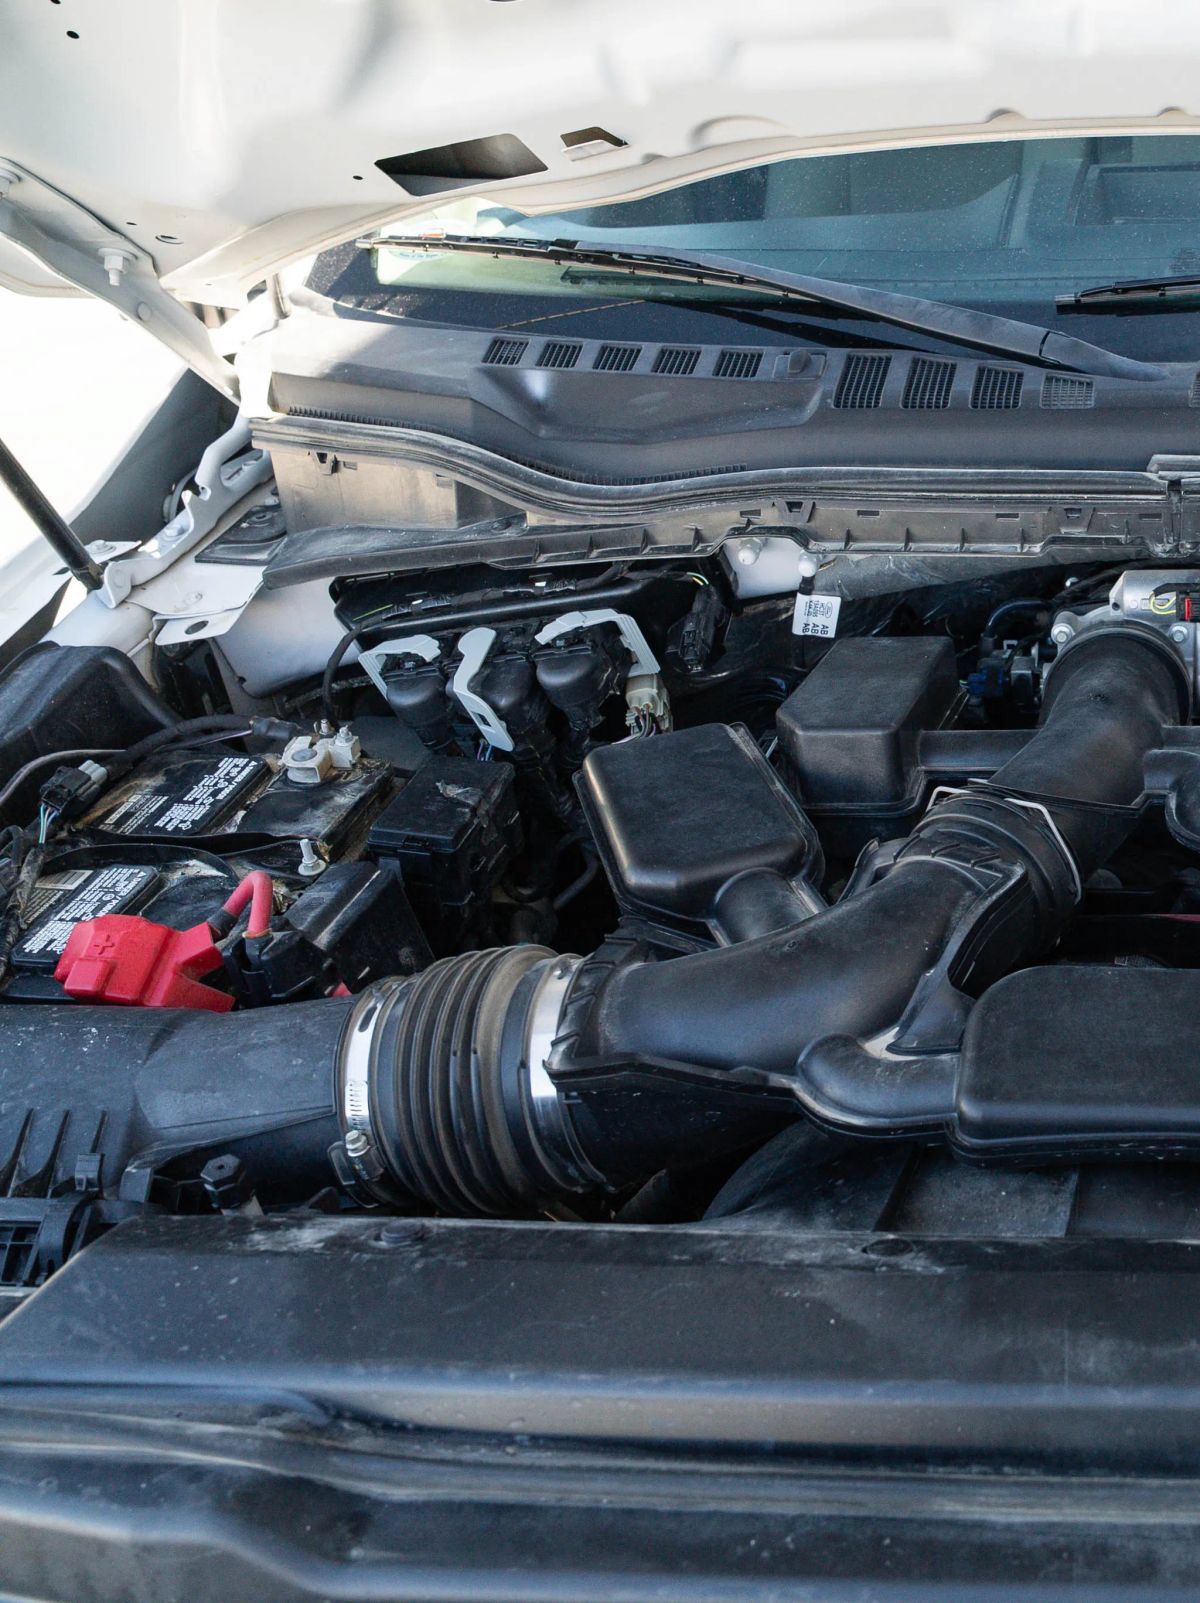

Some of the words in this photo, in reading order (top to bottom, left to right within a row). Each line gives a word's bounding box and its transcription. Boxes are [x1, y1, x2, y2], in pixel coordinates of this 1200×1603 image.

[802, 622, 811, 634] AB
[811, 622, 820, 634] AB
[820, 624, 830, 635] AB
